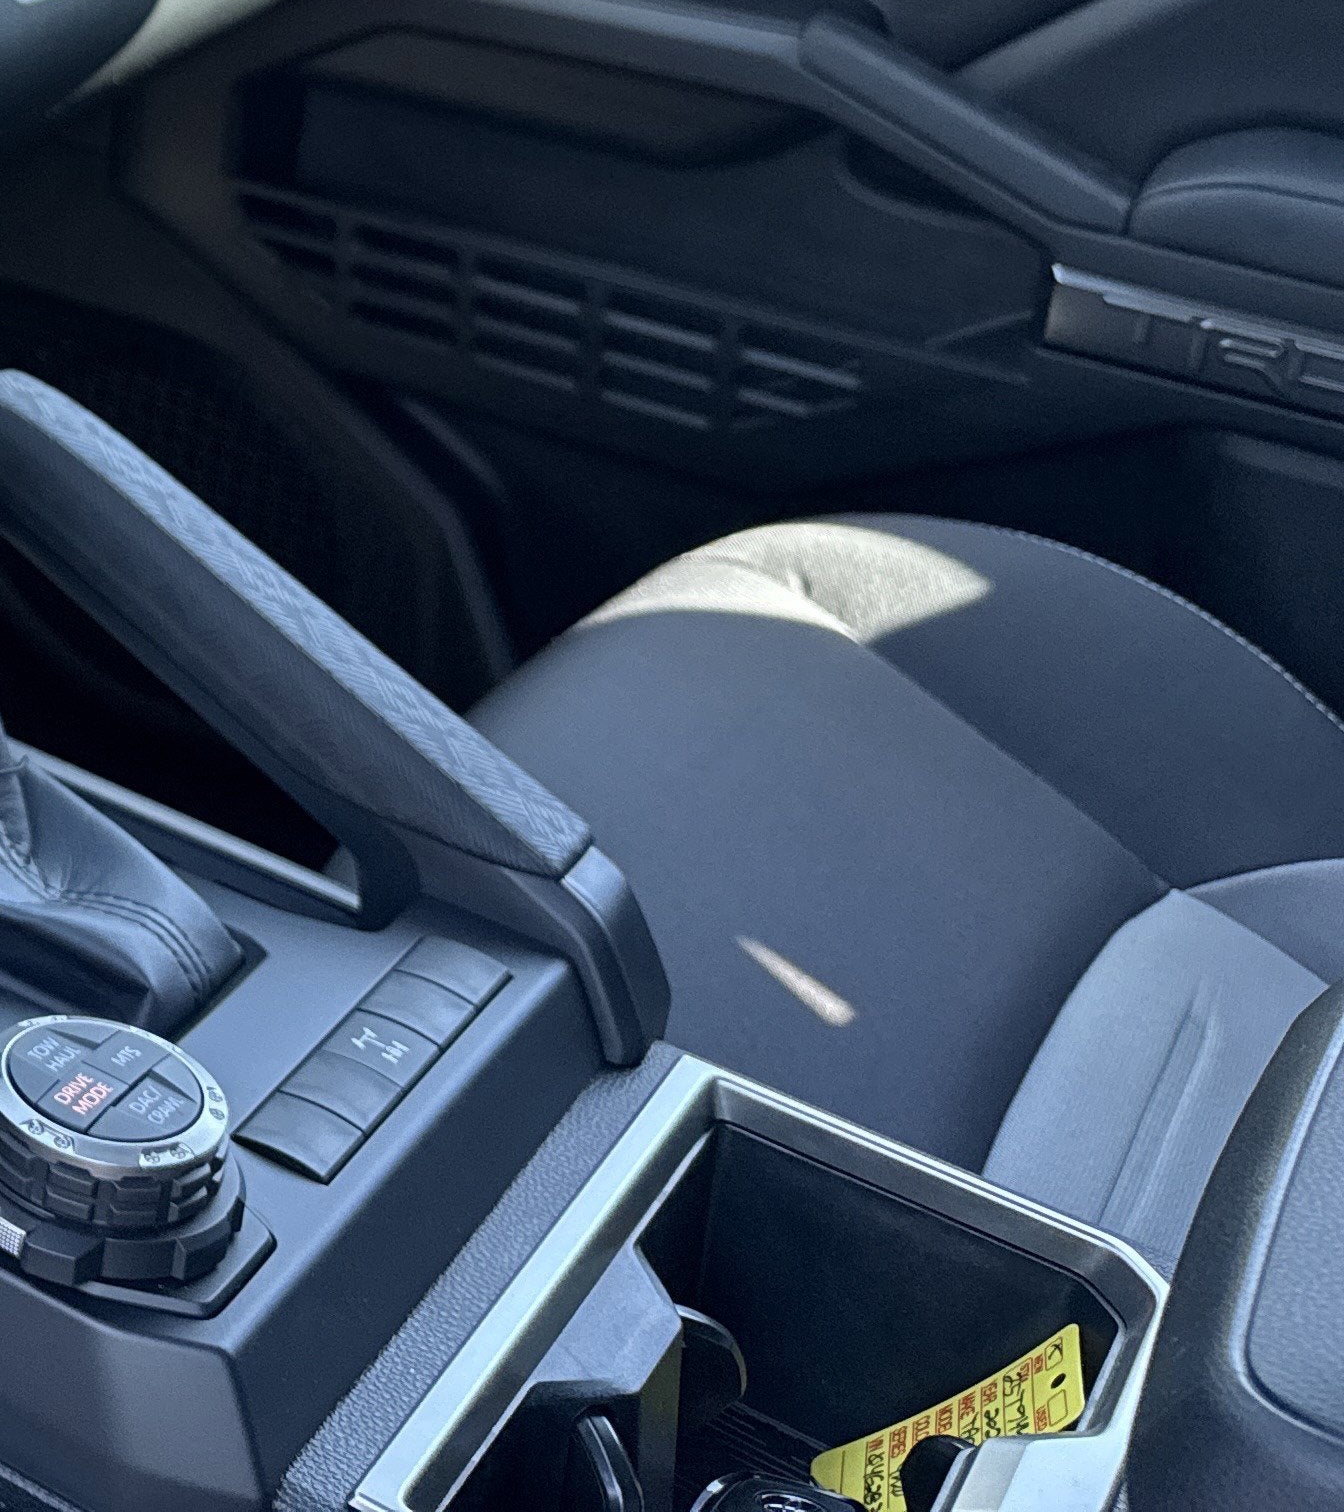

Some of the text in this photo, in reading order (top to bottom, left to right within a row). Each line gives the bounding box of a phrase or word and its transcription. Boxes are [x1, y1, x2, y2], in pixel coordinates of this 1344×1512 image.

[44, 1044, 82, 1073] HAUL
[111, 1044, 142, 1067] MTS
[53, 1072, 95, 1106] DRIVE
[71, 1080, 114, 1116] MODE
